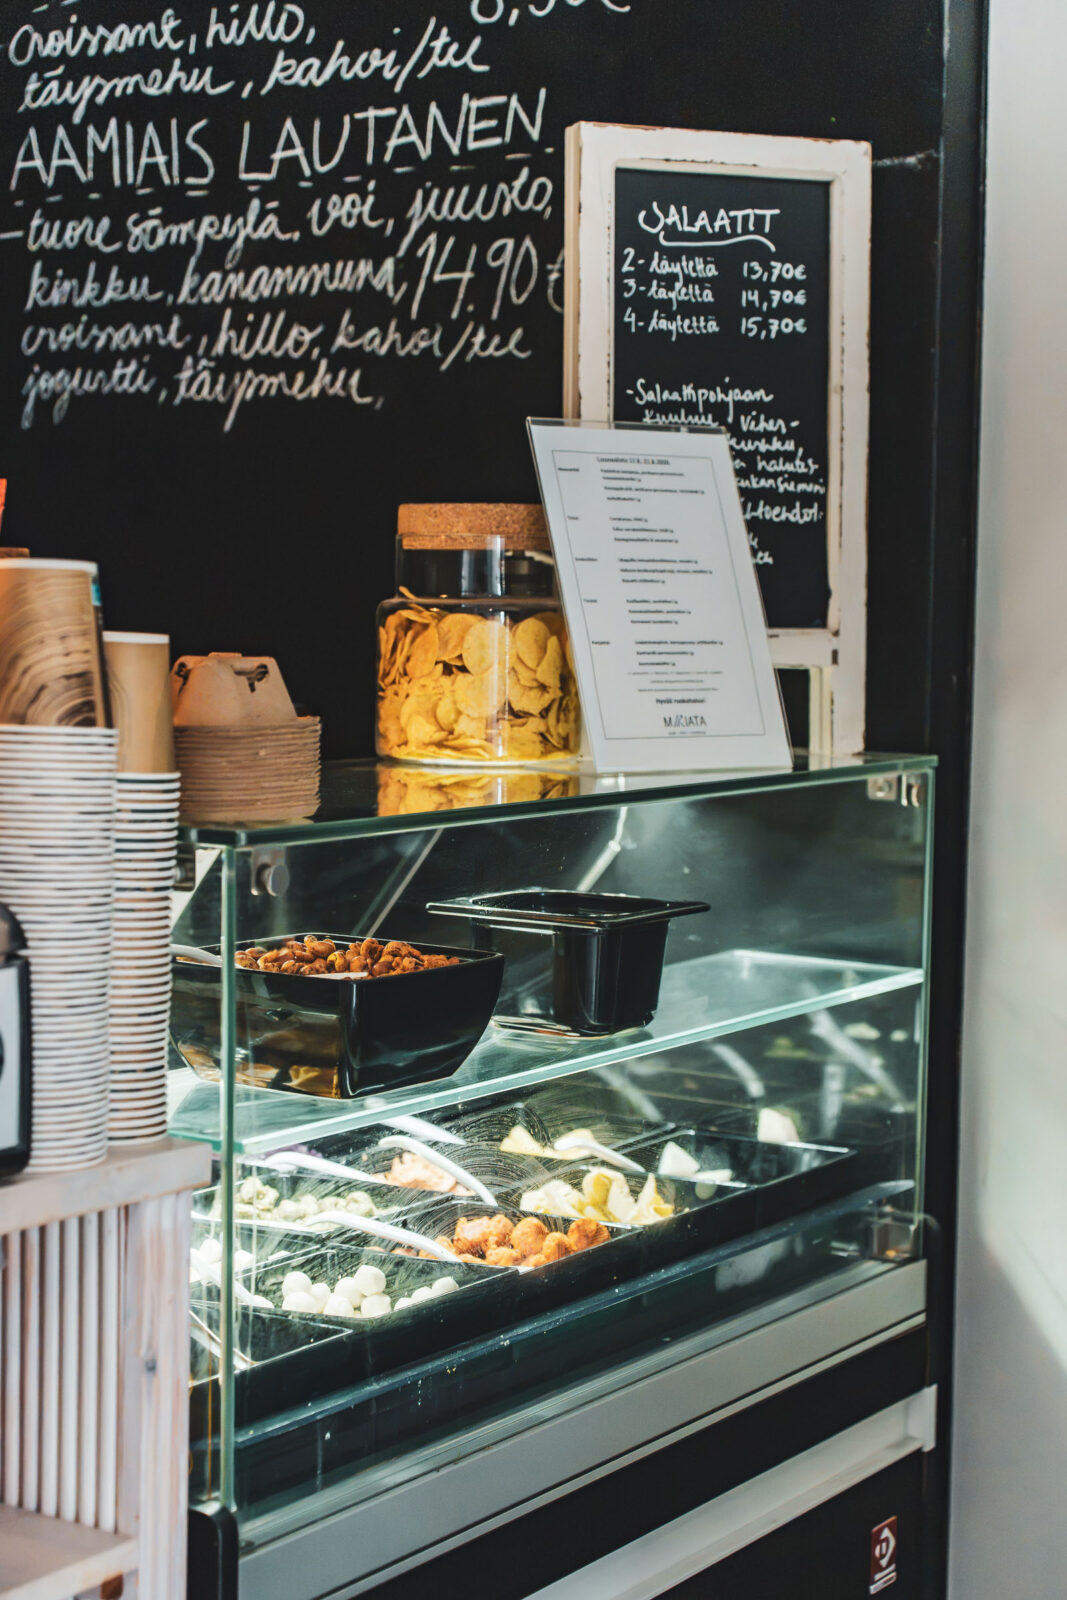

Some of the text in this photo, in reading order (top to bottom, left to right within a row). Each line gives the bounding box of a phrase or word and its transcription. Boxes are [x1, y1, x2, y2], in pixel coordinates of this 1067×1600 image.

[9, 87, 547, 191] AAMIAIS LAUTANEN
[638, 201, 781, 234] SALAATIT
[743, 261, 807, 283] 13,70€
[741, 290, 807, 312] 14,70€
[741, 317, 807, 340] 15,70€
